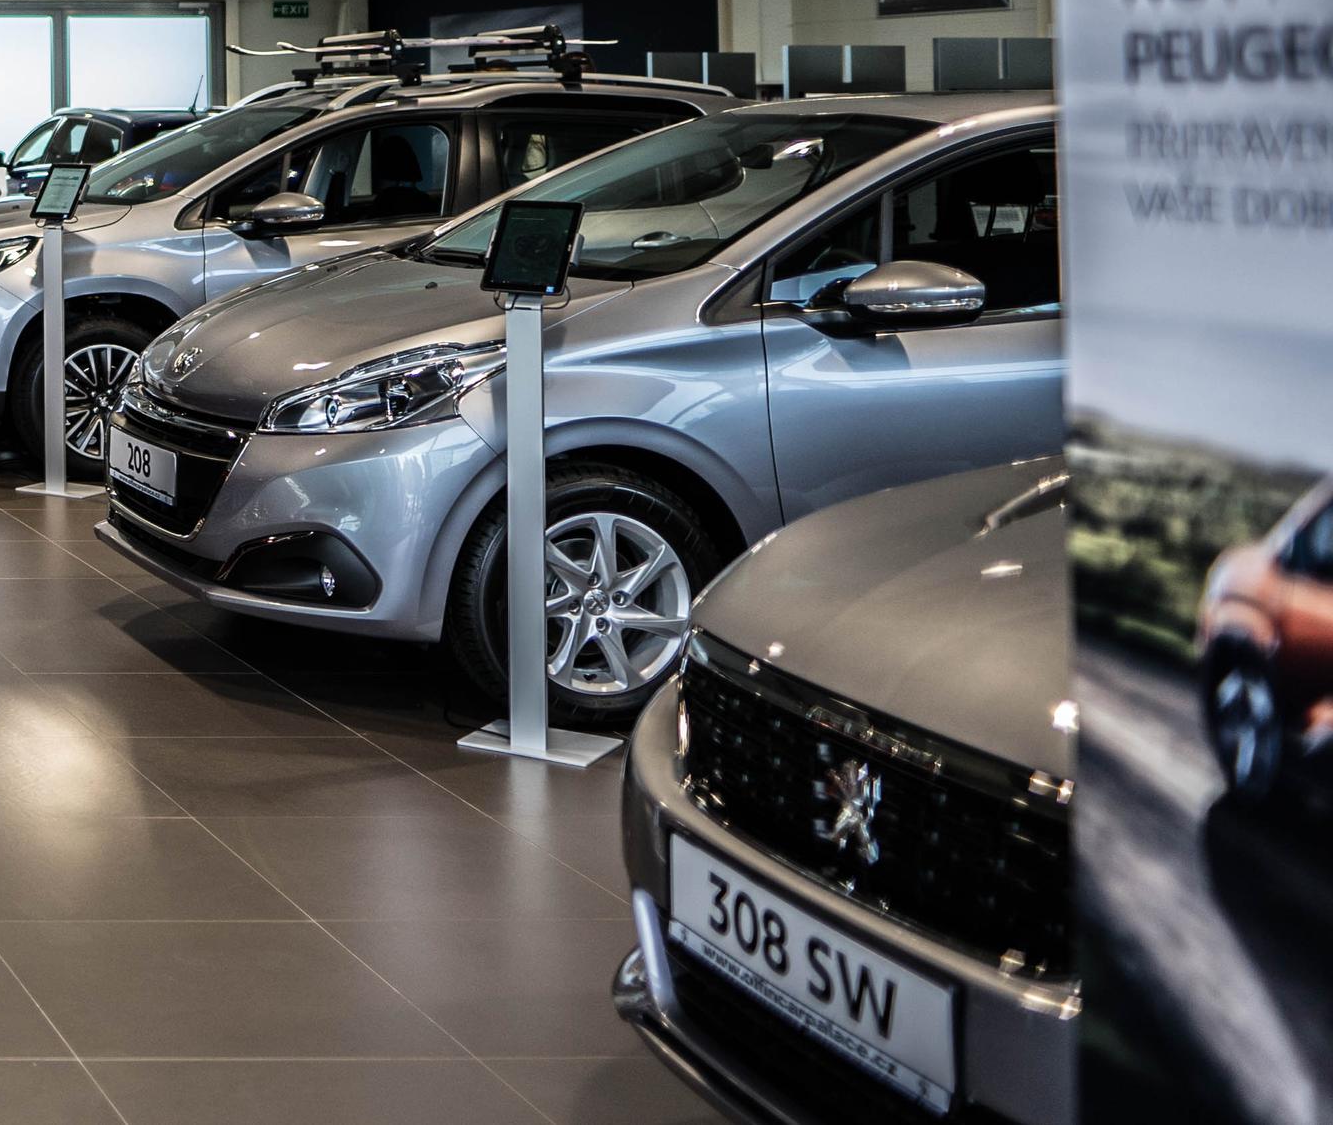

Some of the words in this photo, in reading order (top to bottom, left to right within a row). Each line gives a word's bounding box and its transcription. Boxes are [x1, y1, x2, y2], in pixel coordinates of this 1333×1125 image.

[282, 5, 308, 15] EXIT
[127, 442, 151, 478] 208
[708, 871, 788, 976] 308
[806, 935, 898, 1039] SW
